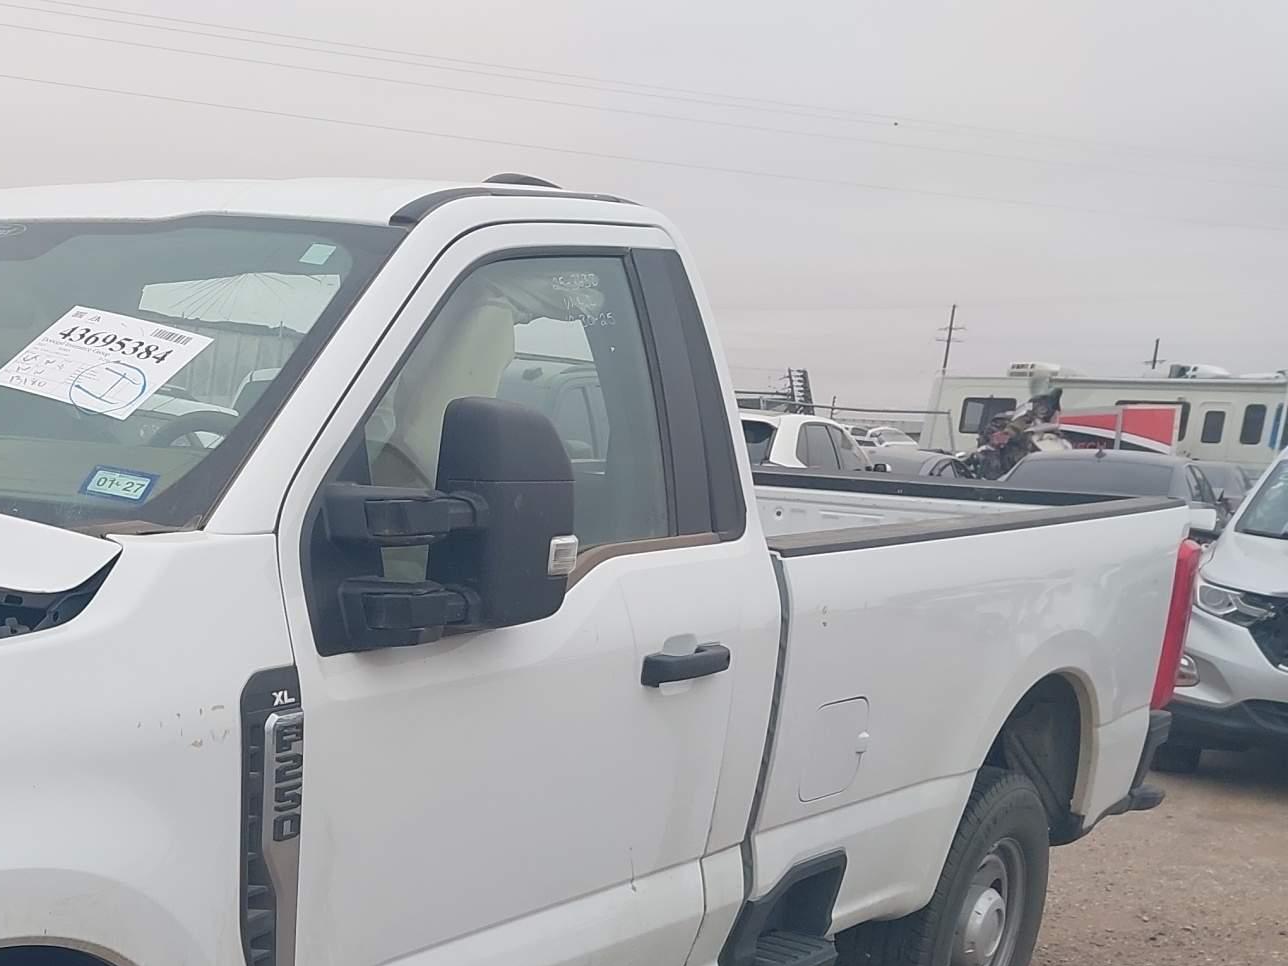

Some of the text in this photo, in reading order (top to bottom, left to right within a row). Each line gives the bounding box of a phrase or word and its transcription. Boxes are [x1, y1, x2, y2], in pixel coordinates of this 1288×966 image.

[59, 326, 174, 364] 43695384
[121, 481, 146, 493] 27
[272, 690, 296, 706] XL
